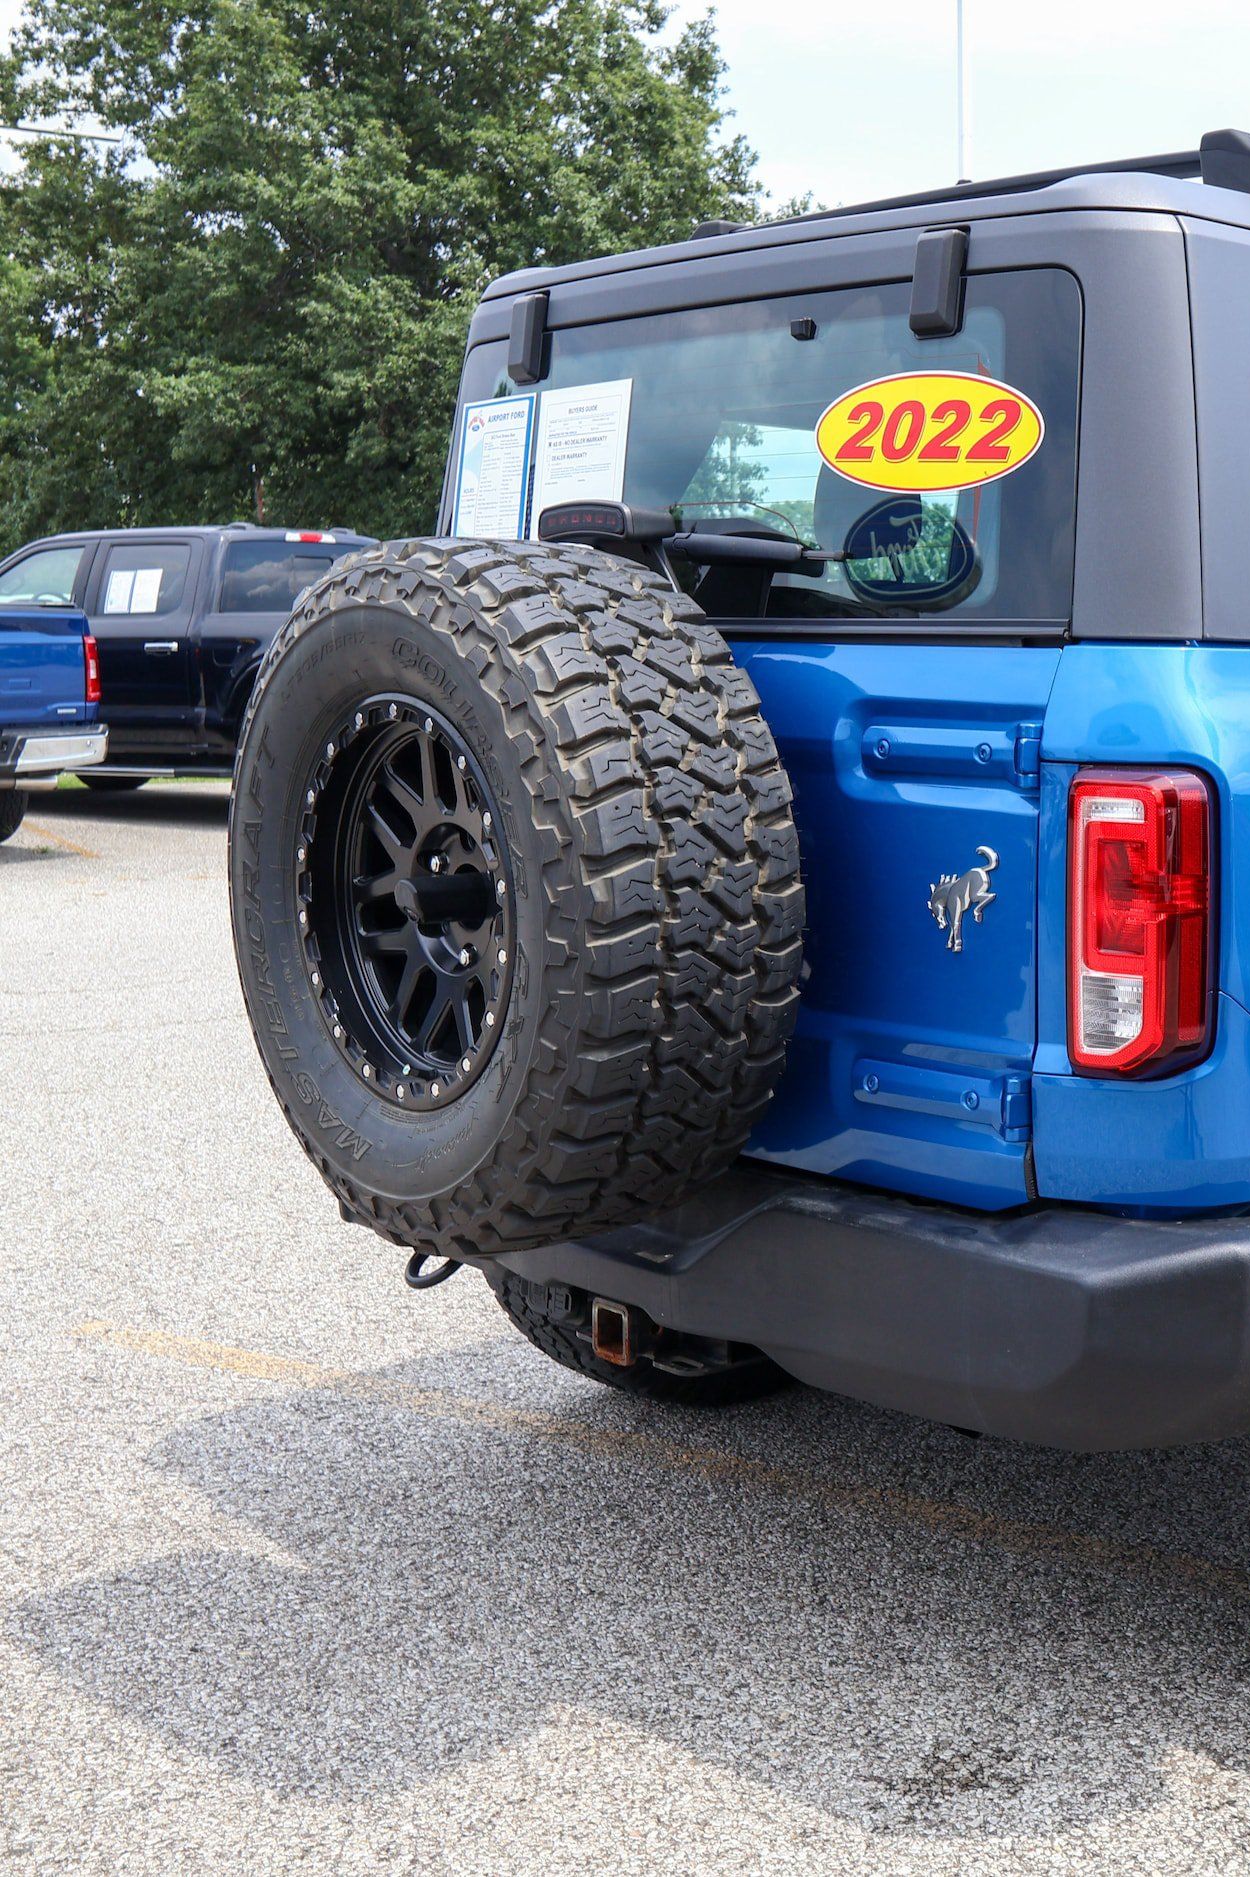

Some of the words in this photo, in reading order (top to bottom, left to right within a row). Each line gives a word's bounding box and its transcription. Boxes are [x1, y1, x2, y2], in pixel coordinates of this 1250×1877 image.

[488, 412, 510, 423] AIRPORT
[511, 410, 525, 419] FORD
[835, 399, 1023, 463] 2022
[240, 724, 375, 1164] MASTERCRAFT
